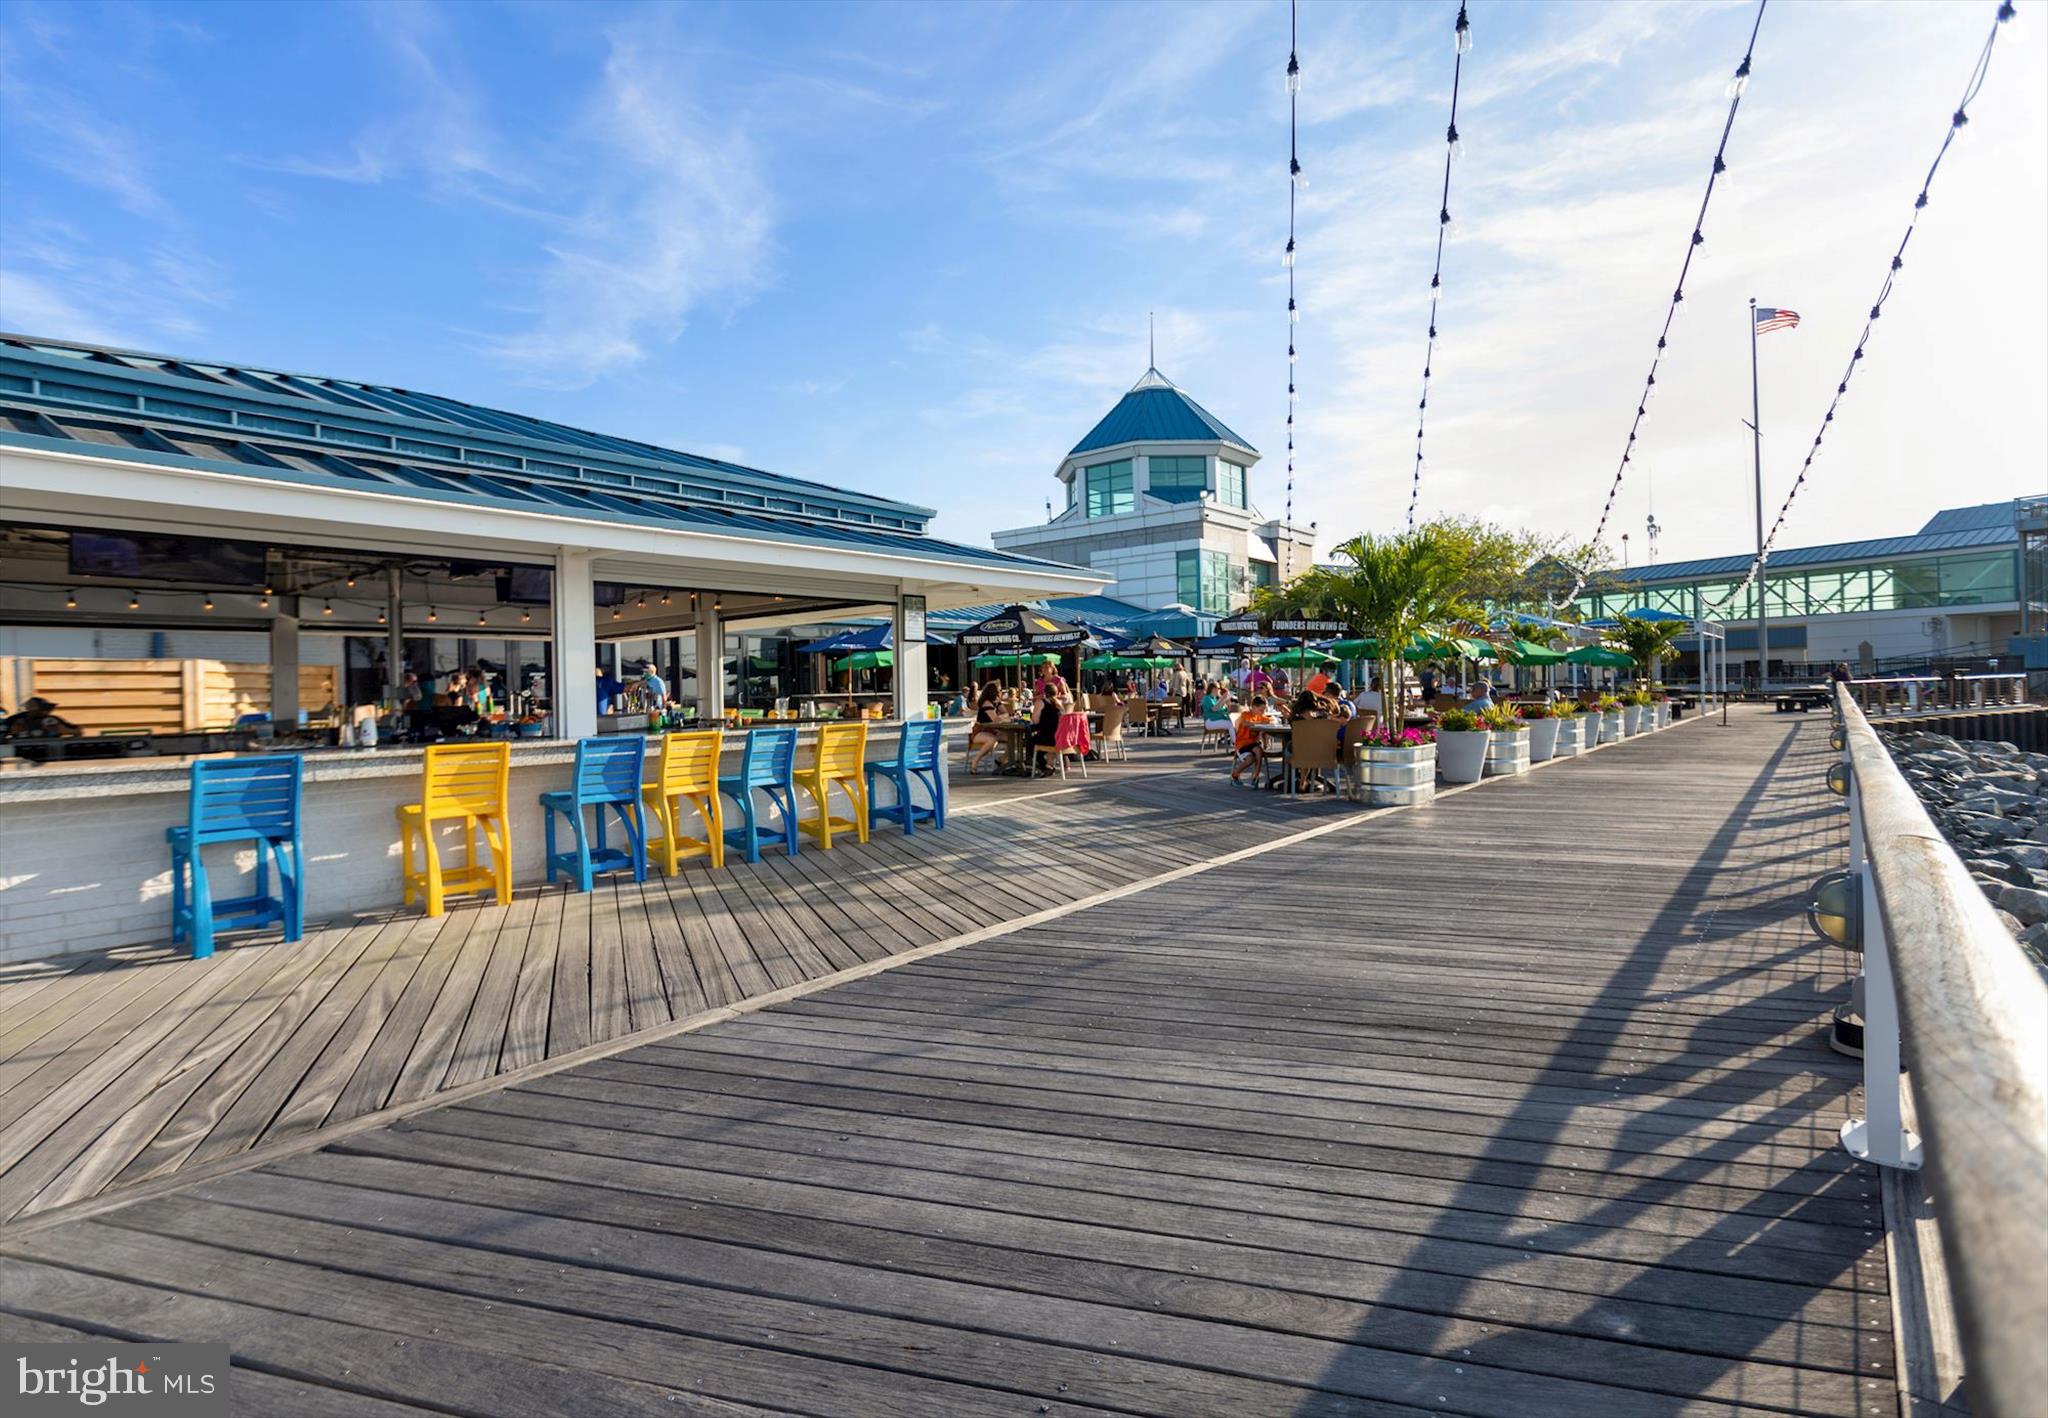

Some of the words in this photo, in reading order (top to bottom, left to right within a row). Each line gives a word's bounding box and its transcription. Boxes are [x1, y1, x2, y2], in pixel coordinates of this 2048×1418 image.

[1272, 621, 1305, 630] FOUNDERS
[1307, 621, 1337, 631] BREWING
[1339, 621, 1349, 631] CO.
[963, 635, 988, 644] FOUNDERS
[989, 635, 1011, 643] BREWING
[1011, 634, 1021, 643] CO.
